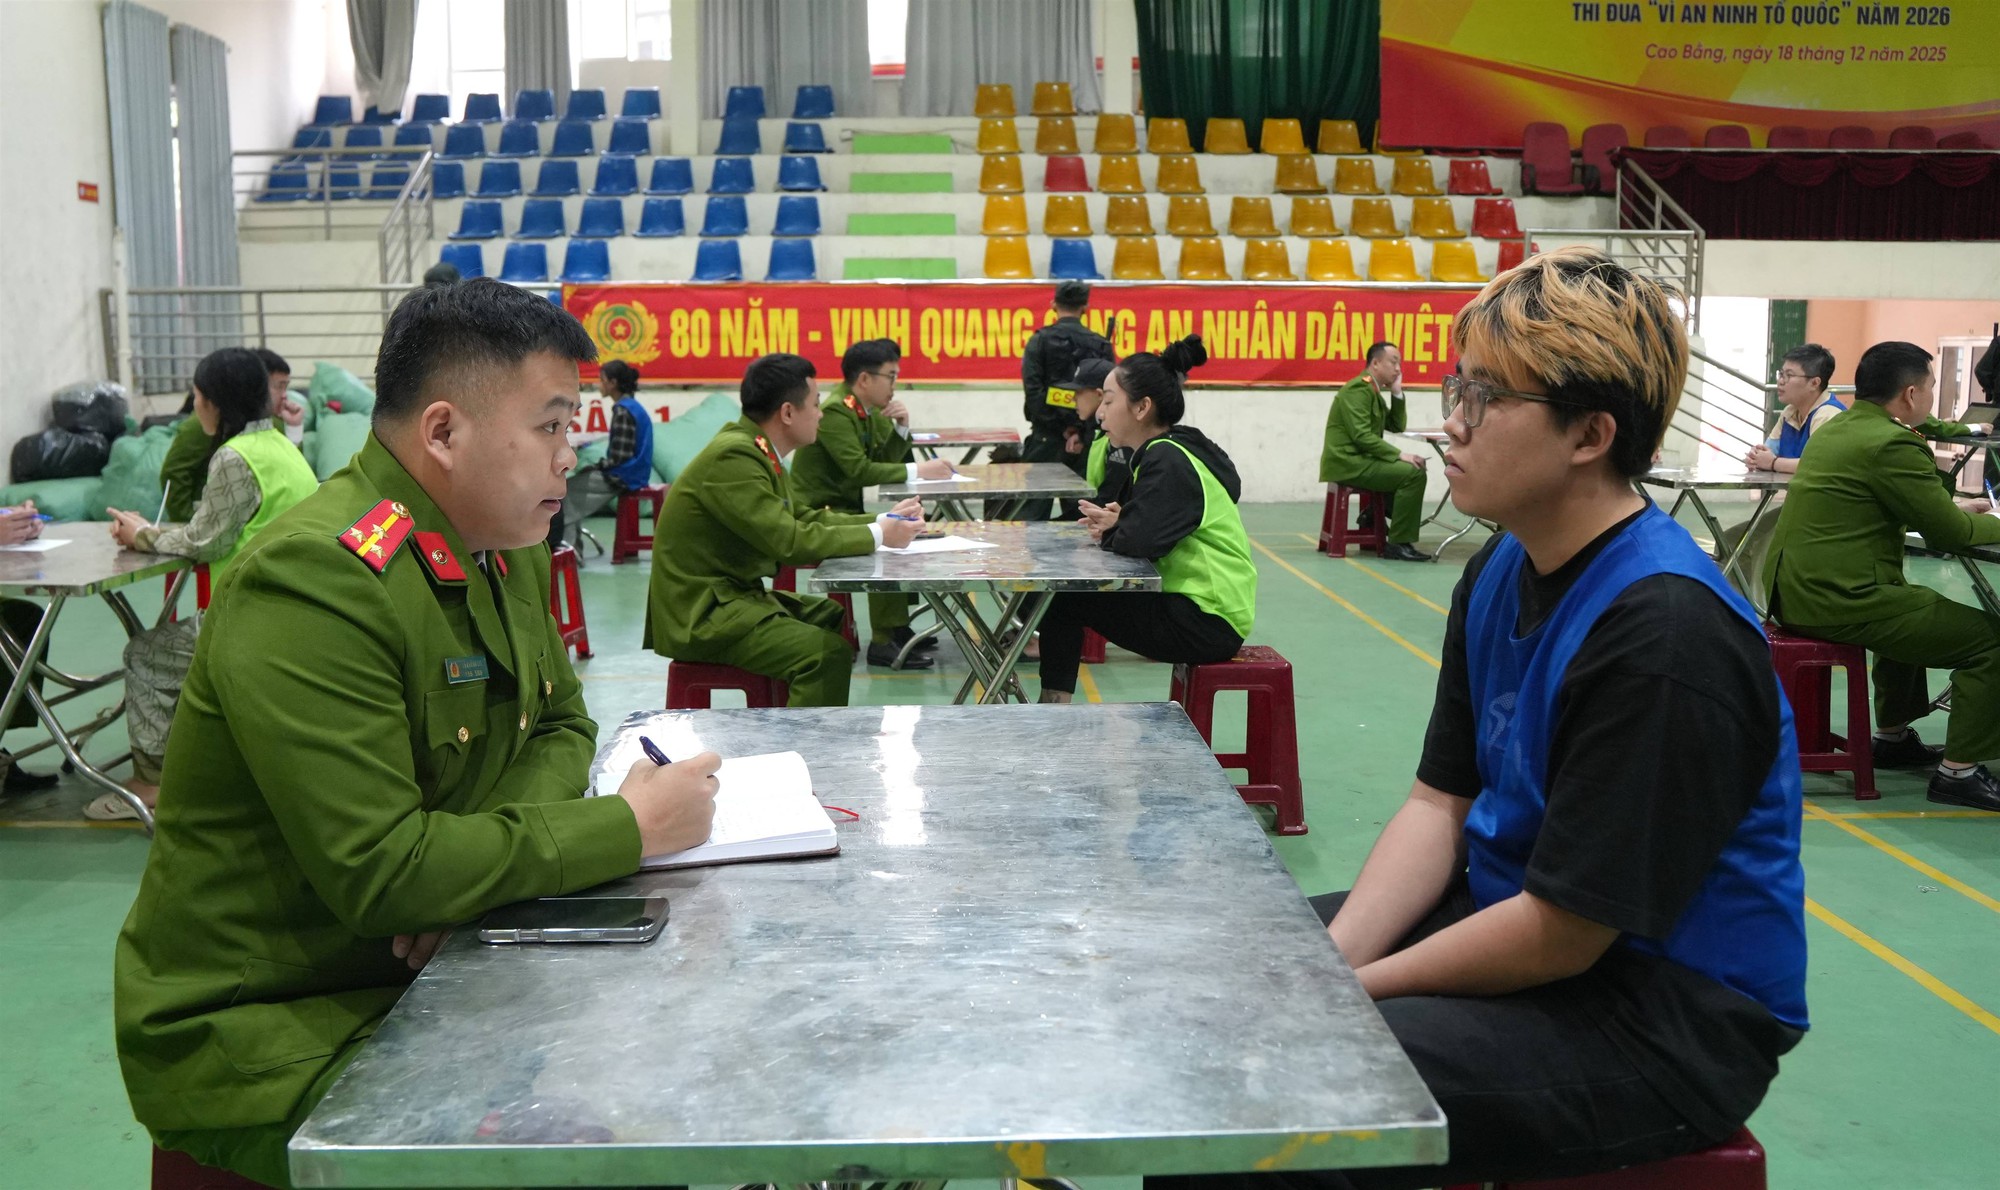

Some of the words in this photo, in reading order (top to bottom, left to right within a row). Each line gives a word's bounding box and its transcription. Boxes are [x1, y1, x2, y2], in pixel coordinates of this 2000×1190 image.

[1573, 3, 1600, 22] THI
[1606, 3, 1642, 22] ĐUA
[1681, 4, 1706, 23] AN
[1712, 5, 1757, 24] NINH
[1856, 2, 1900, 26] NĂM
[1905, 6, 1950, 26] 2026
[1645, 43, 1678, 59] Cao
[1732, 45, 1773, 64] ngày
[1777, 45, 1794, 61] 18
[1798, 46, 1845, 65] tháng
[1850, 46, 1865, 61] 12
[1869, 46, 1904, 62] năm
[1908, 46, 1947, 62] 2025
[669, 308, 711, 358] 80
[719, 297, 798, 358] NĂM
[829, 307, 911, 358] VINH
[919, 307, 1034, 363] QUANG
[1145, 309, 1193, 354] AN
[1201, 299, 1297, 359] NHÂN
[1305, 300, 1375, 360] DÂN
[1383, 302, 1454, 374] VIỆT
